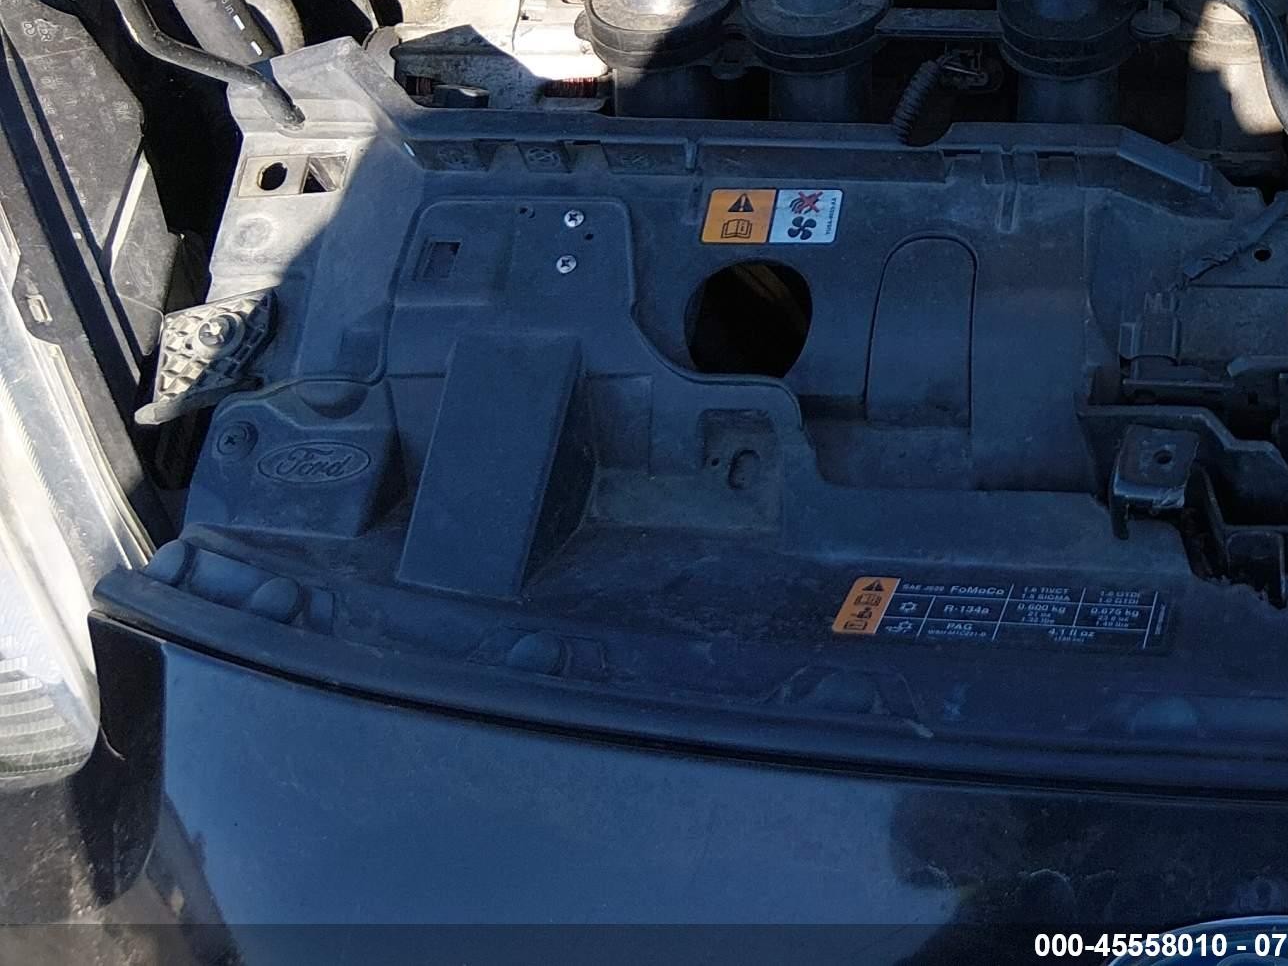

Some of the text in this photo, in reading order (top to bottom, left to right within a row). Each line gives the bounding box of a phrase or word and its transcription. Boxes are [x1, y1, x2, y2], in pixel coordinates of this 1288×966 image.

[276, 447, 353, 477] Ford
[950, 585, 1005, 595] FoMoCo
[944, 604, 990, 614] R-134a
[946, 622, 973, 630] PAG
